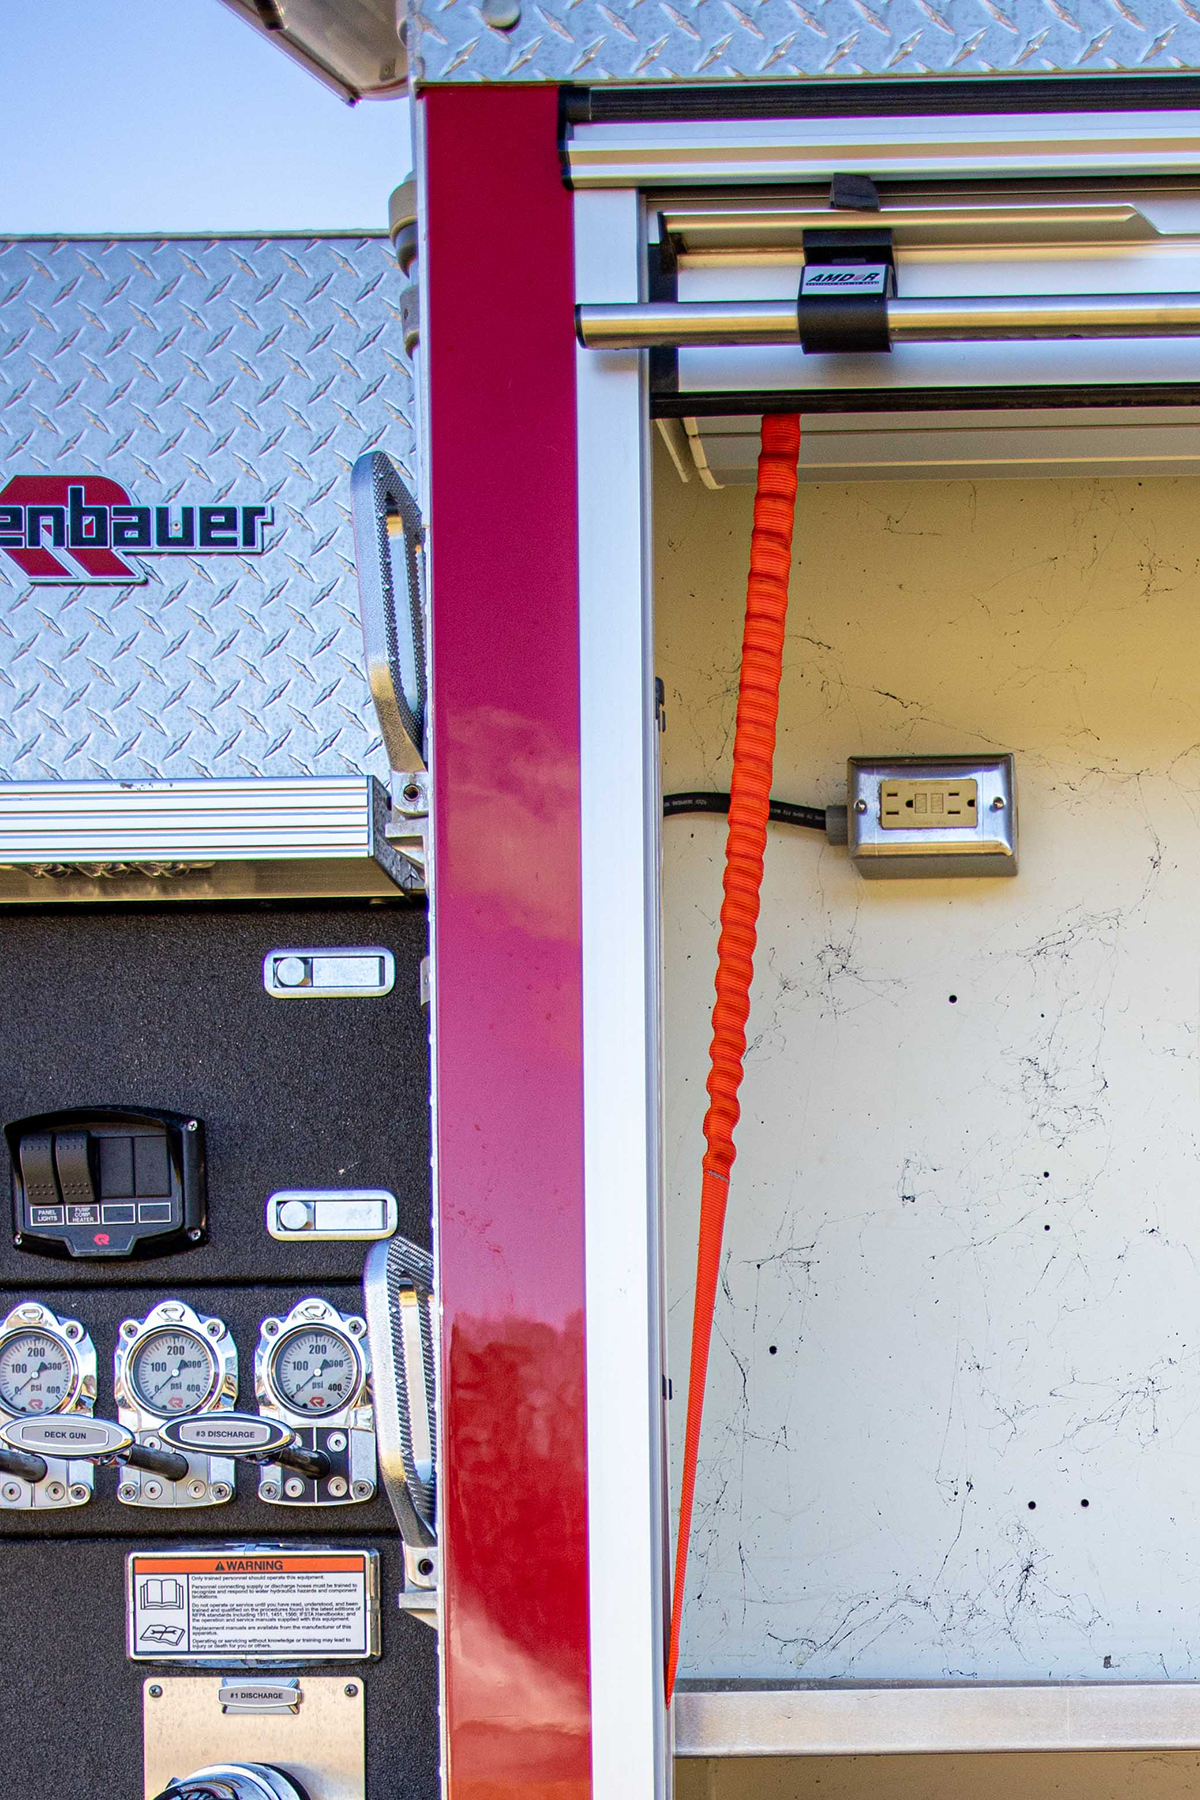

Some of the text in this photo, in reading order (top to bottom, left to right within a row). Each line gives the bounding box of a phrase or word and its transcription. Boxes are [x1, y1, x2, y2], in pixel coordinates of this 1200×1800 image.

[0, 486, 266, 548] enbauer
[27, 1347, 45, 1358] 200
[167, 1345, 185, 1356] 200
[309, 1344, 327, 1355] 200
[47, 1362, 62, 1371] 300
[151, 1362, 167, 1372] 100
[187, 1360, 202, 1369] 300
[292, 1360, 308, 1371] 100
[329, 1359, 344, 1368] 300
[11, 1363, 27, 1374] 100
[30, 1383, 42, 1392] psi
[46, 1386, 60, 1394] 400
[170, 1382, 182, 1391] psi
[186, 1384, 200, 1392] 400
[312, 1381, 323, 1390] psi
[328, 1383, 342, 1392] 400
[44, 1430, 87, 1439] DECK GUN
[208, 1430, 255, 1438] DISCHARGE
[226, 1560, 283, 1571] WARNING
